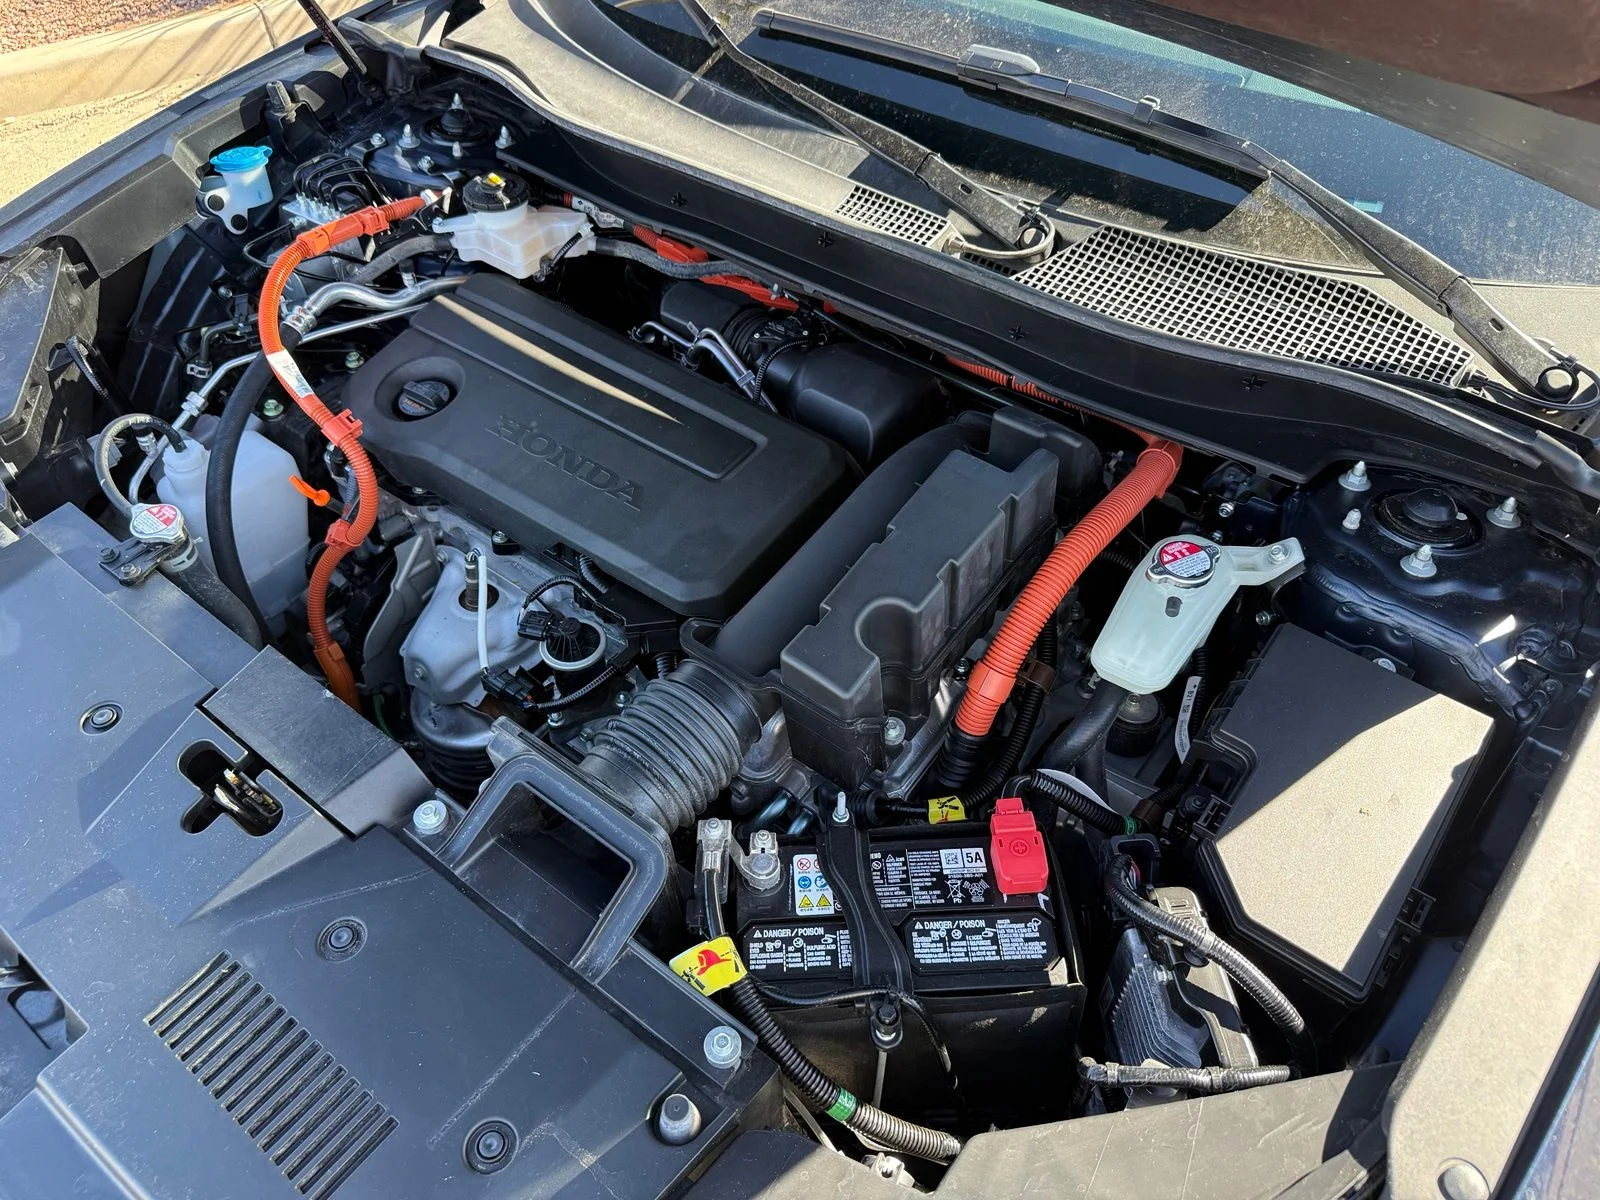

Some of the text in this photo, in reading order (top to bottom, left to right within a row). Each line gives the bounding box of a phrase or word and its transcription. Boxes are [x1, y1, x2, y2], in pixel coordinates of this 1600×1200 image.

[485, 415, 644, 511] HONDA
[966, 851, 983, 863] 5A
[924, 921, 952, 929] DANGER
[959, 920, 985, 928] POISON
[763, 928, 791, 937] DANGER
[798, 927, 824, 936] POISON
